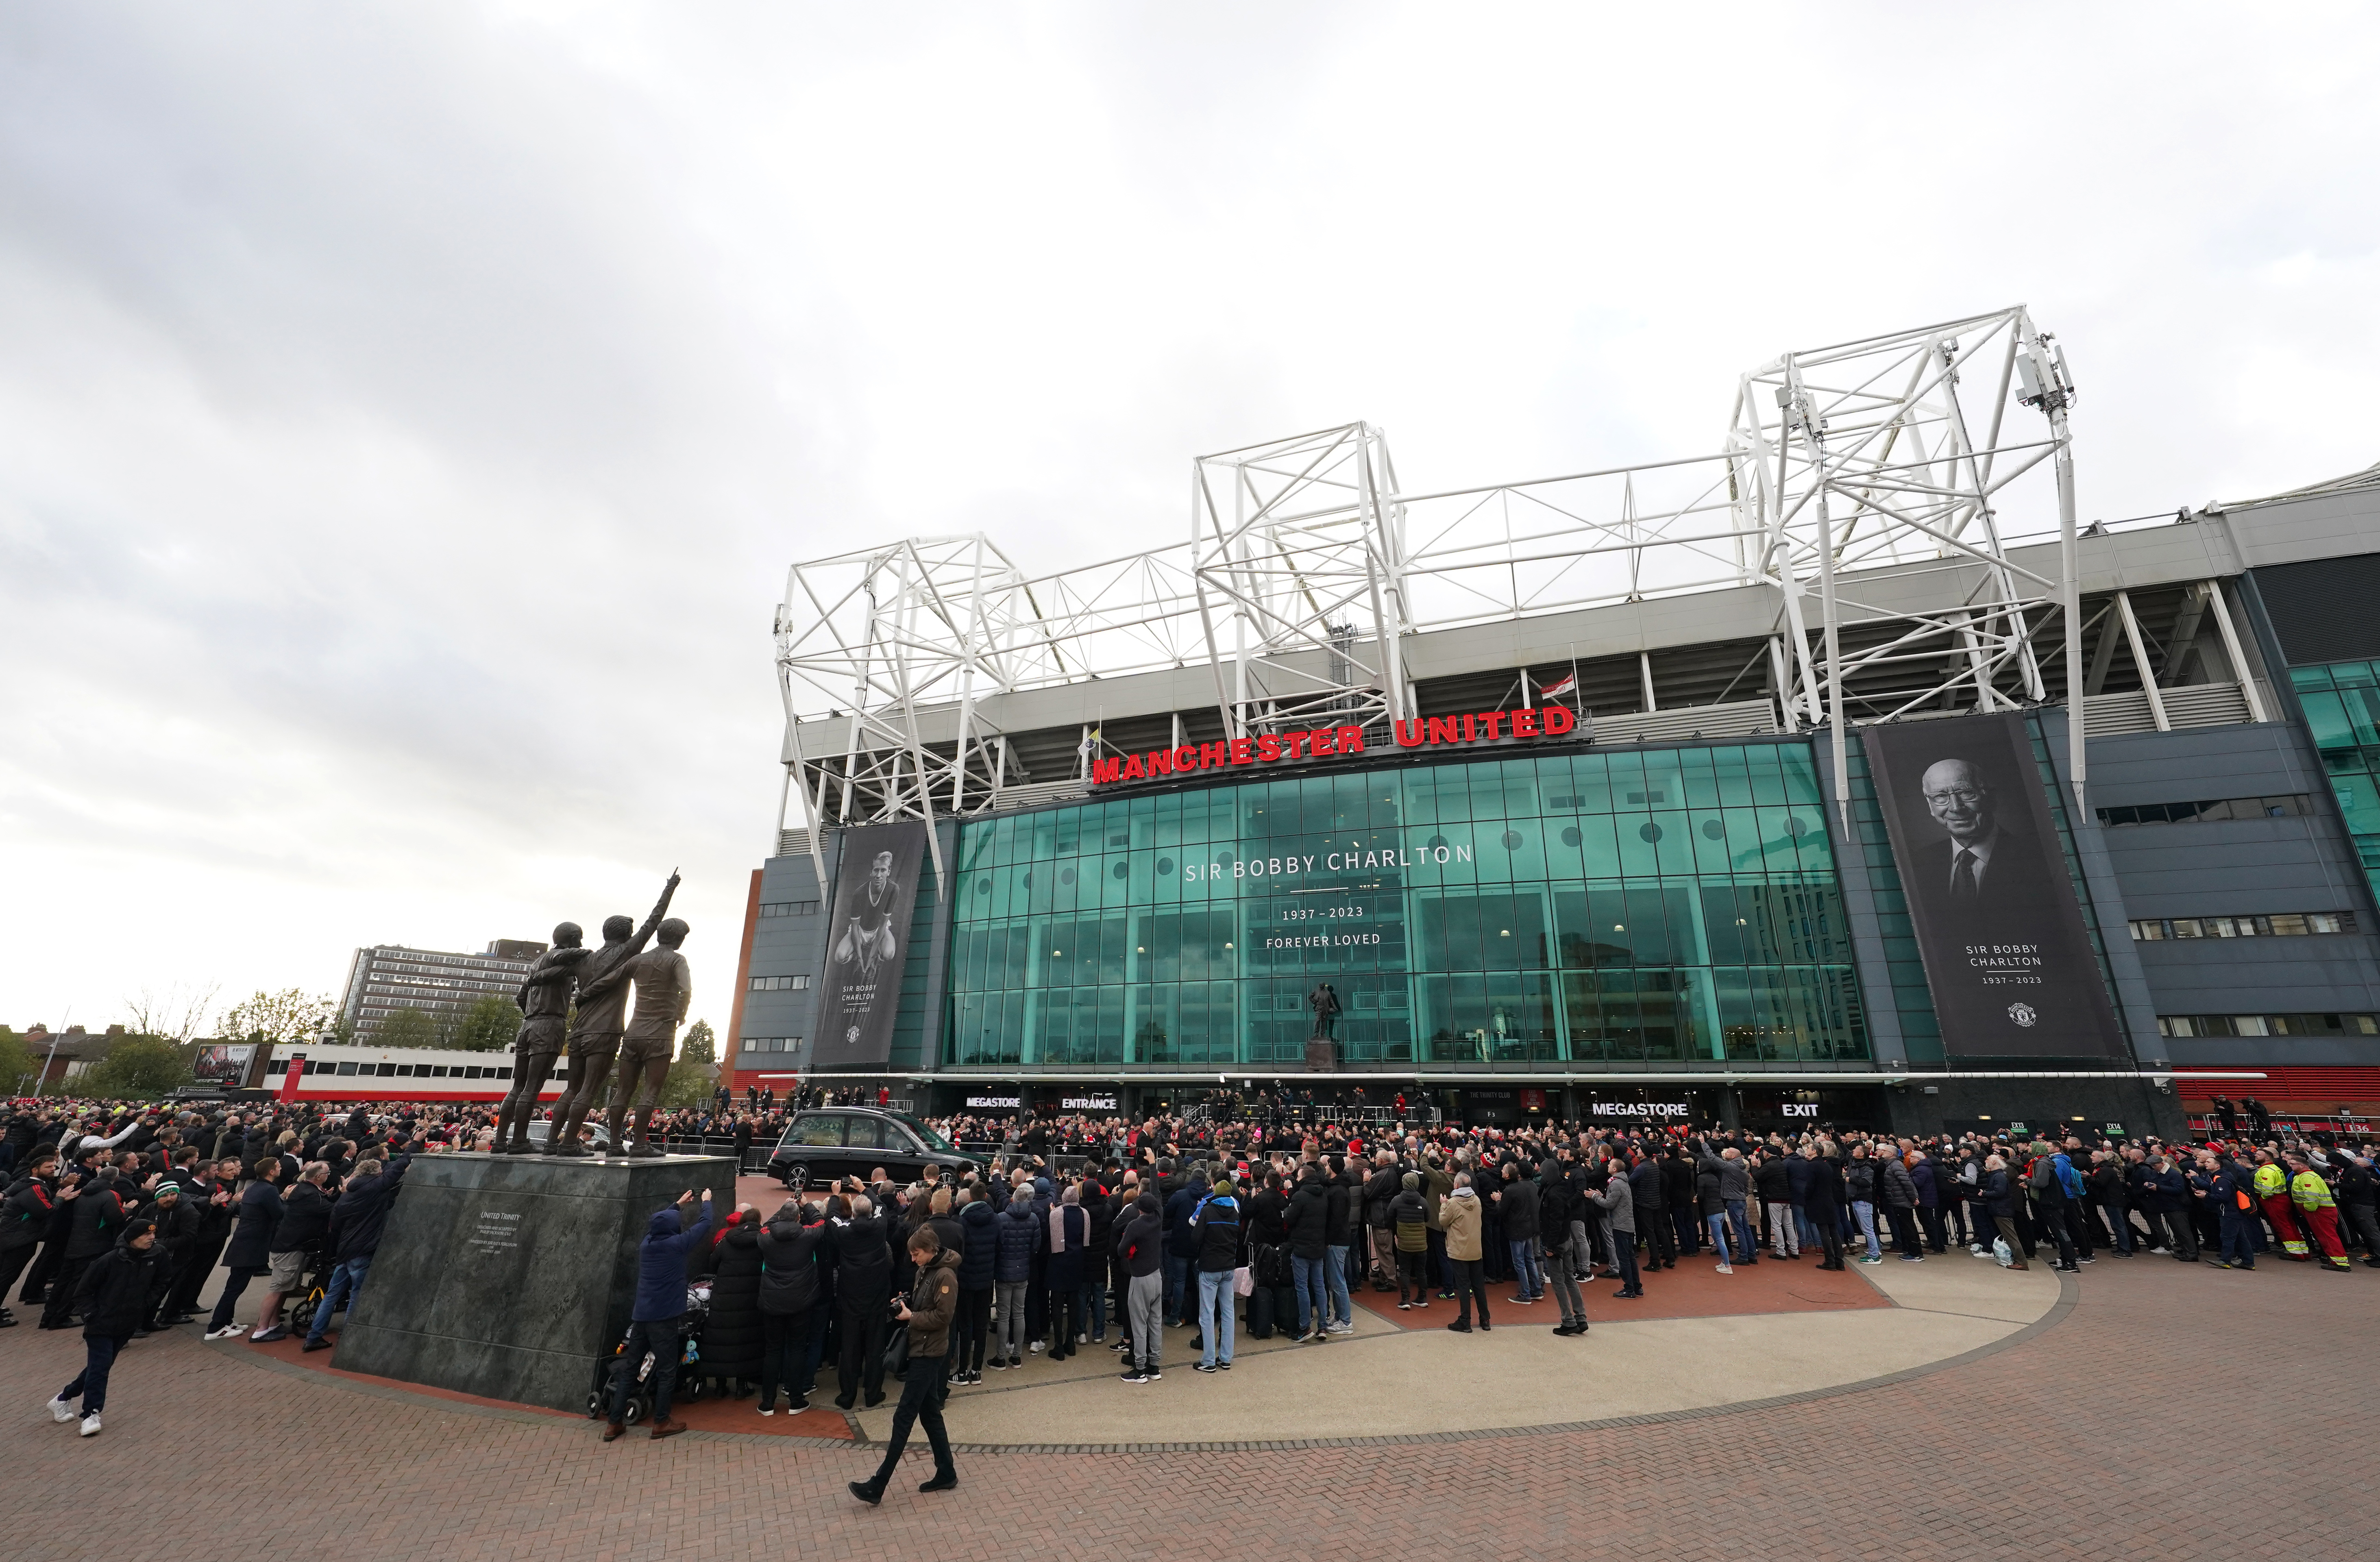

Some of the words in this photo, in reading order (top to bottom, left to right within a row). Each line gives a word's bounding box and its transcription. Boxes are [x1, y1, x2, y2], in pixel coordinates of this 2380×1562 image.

[1093, 725, 1364, 784] MANCHESTER
[1396, 706, 1573, 746] UNITED
[1185, 863, 1221, 881] SIR
[1234, 855, 1314, 878] BOBBY
[1328, 845, 1471, 870] CHARLTON
[1267, 936, 1329, 948] FOREVER
[1335, 934, 1380, 945] LOVED
[1993, 945, 2037, 953] BOBBY
[1971, 957, 2041, 966] CHARLTON
[967, 1097, 1020, 1107] MEGASTORE
[1062, 1098, 1117, 1109] ENTRANCE
[1592, 1103, 1688, 1116] MEGASTORE
[1782, 1104, 1818, 1116] EXIT
